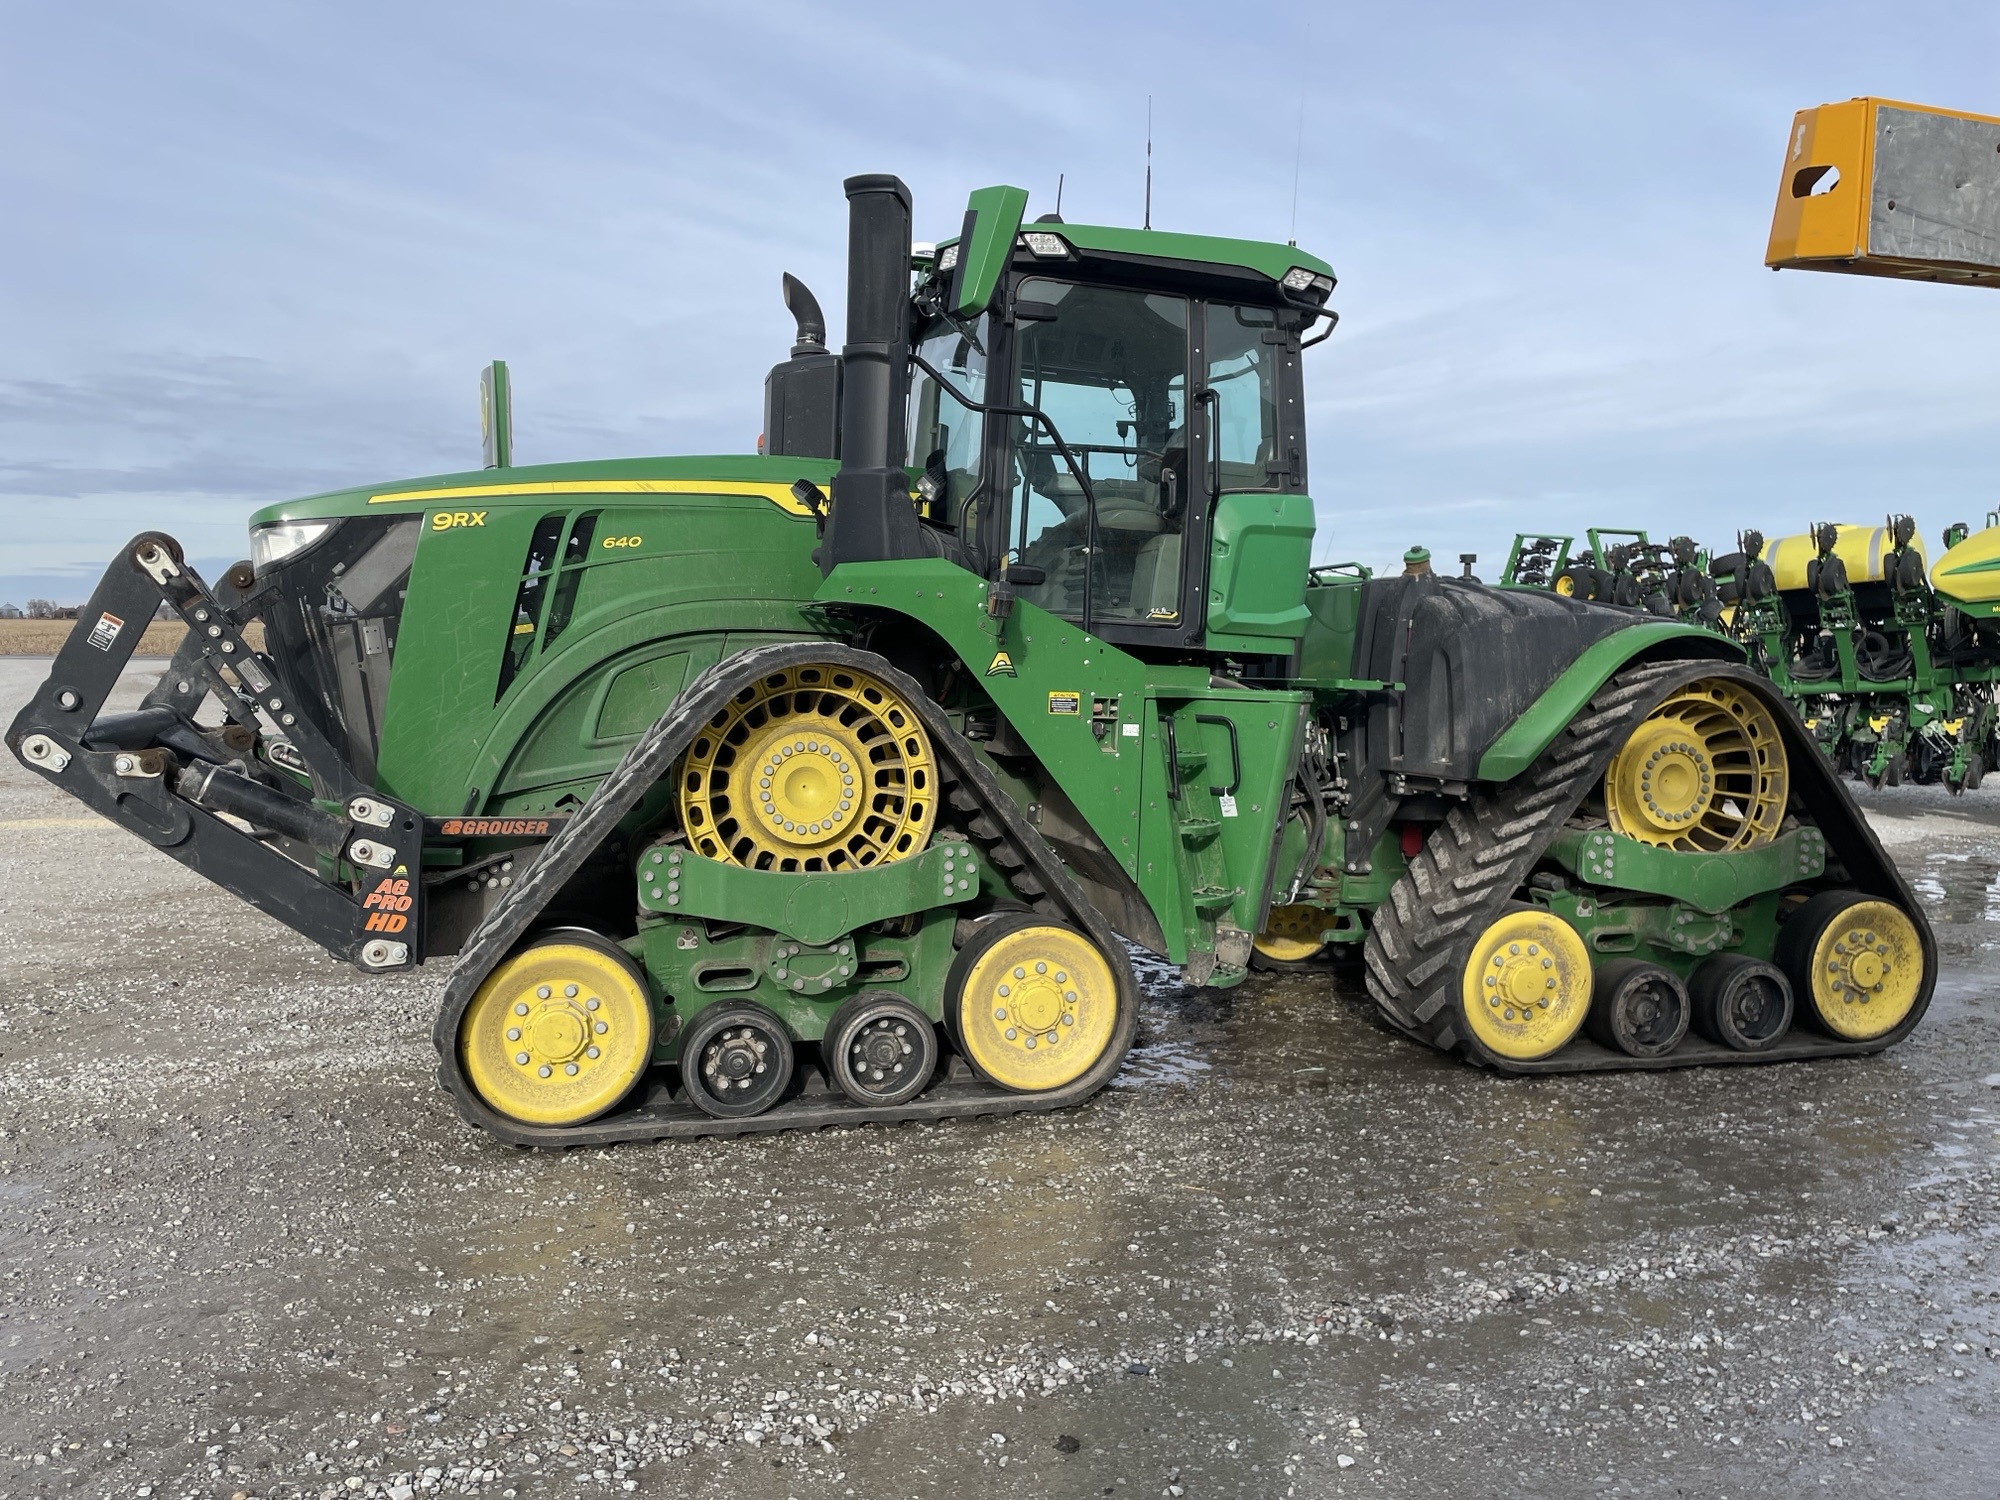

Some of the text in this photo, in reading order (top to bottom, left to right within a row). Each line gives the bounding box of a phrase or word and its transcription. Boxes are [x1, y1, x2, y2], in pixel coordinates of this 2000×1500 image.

[431, 511, 489, 531] 9RX
[602, 535, 642, 549] 640
[462, 820, 549, 835] GROUSER
[374, 878, 410, 895] AG
[362, 893, 413, 912] PRO
[364, 912, 408, 933] HD
